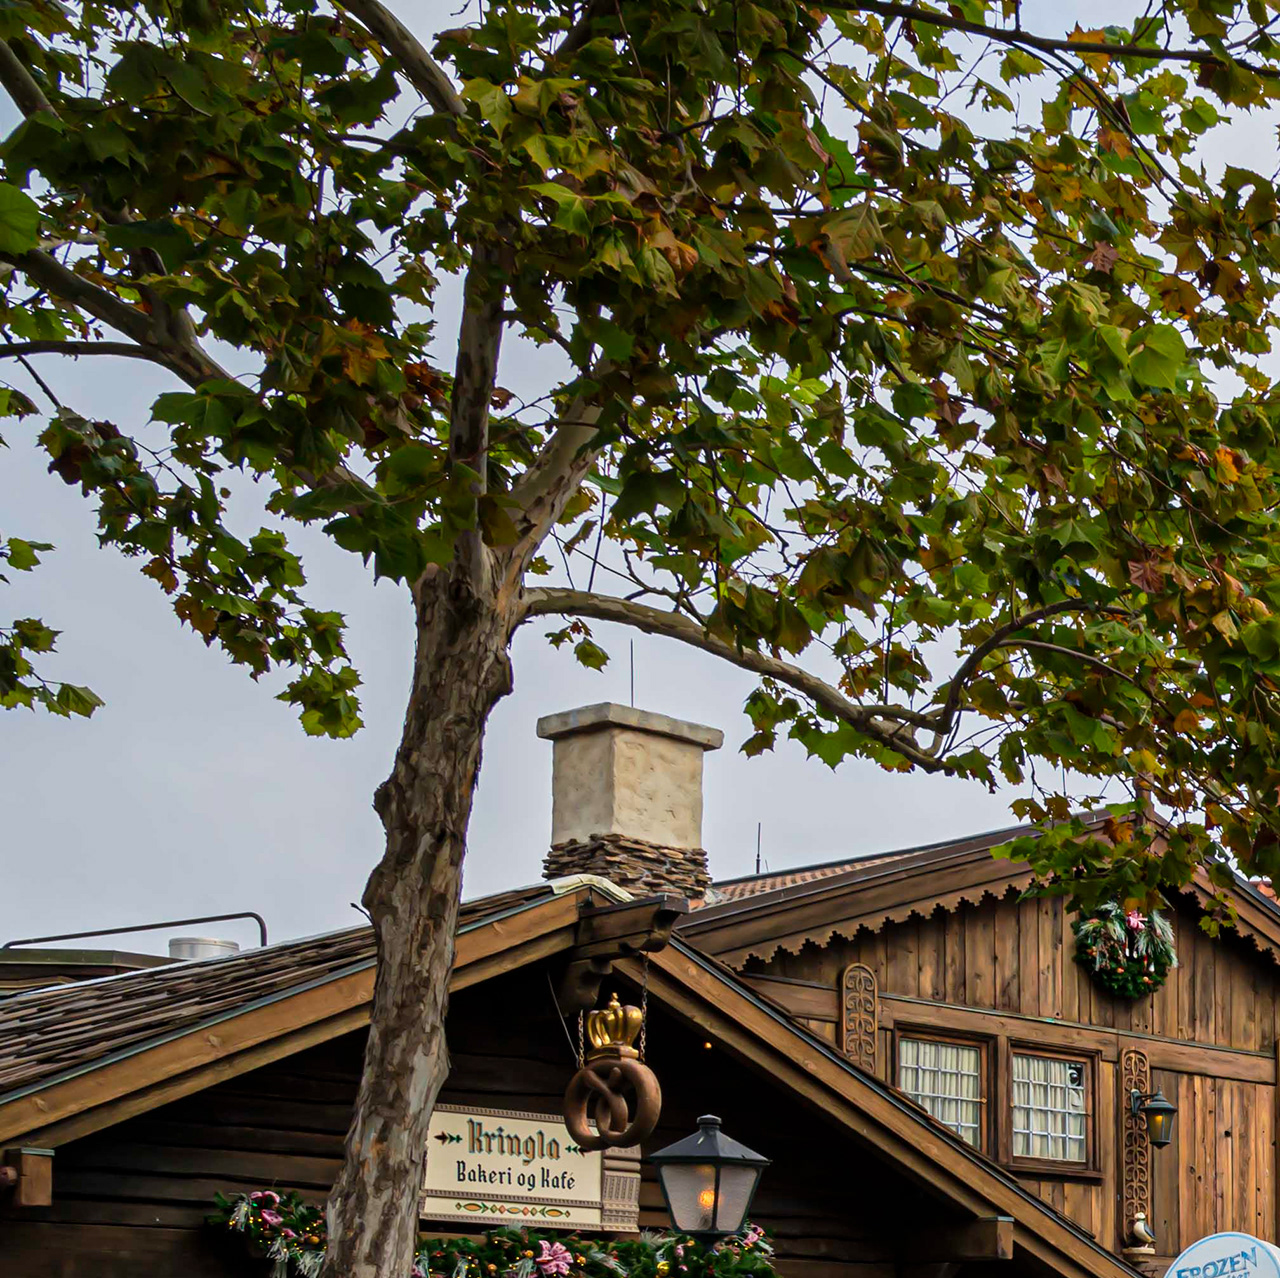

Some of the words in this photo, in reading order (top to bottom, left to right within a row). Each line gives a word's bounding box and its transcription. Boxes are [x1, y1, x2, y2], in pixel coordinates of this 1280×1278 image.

[466, 1117, 561, 1167] Kringla
[456, 1160, 511, 1186] Bakeri
[516, 1172, 536, 1191] og
[540, 1166, 576, 1190] Kafé
